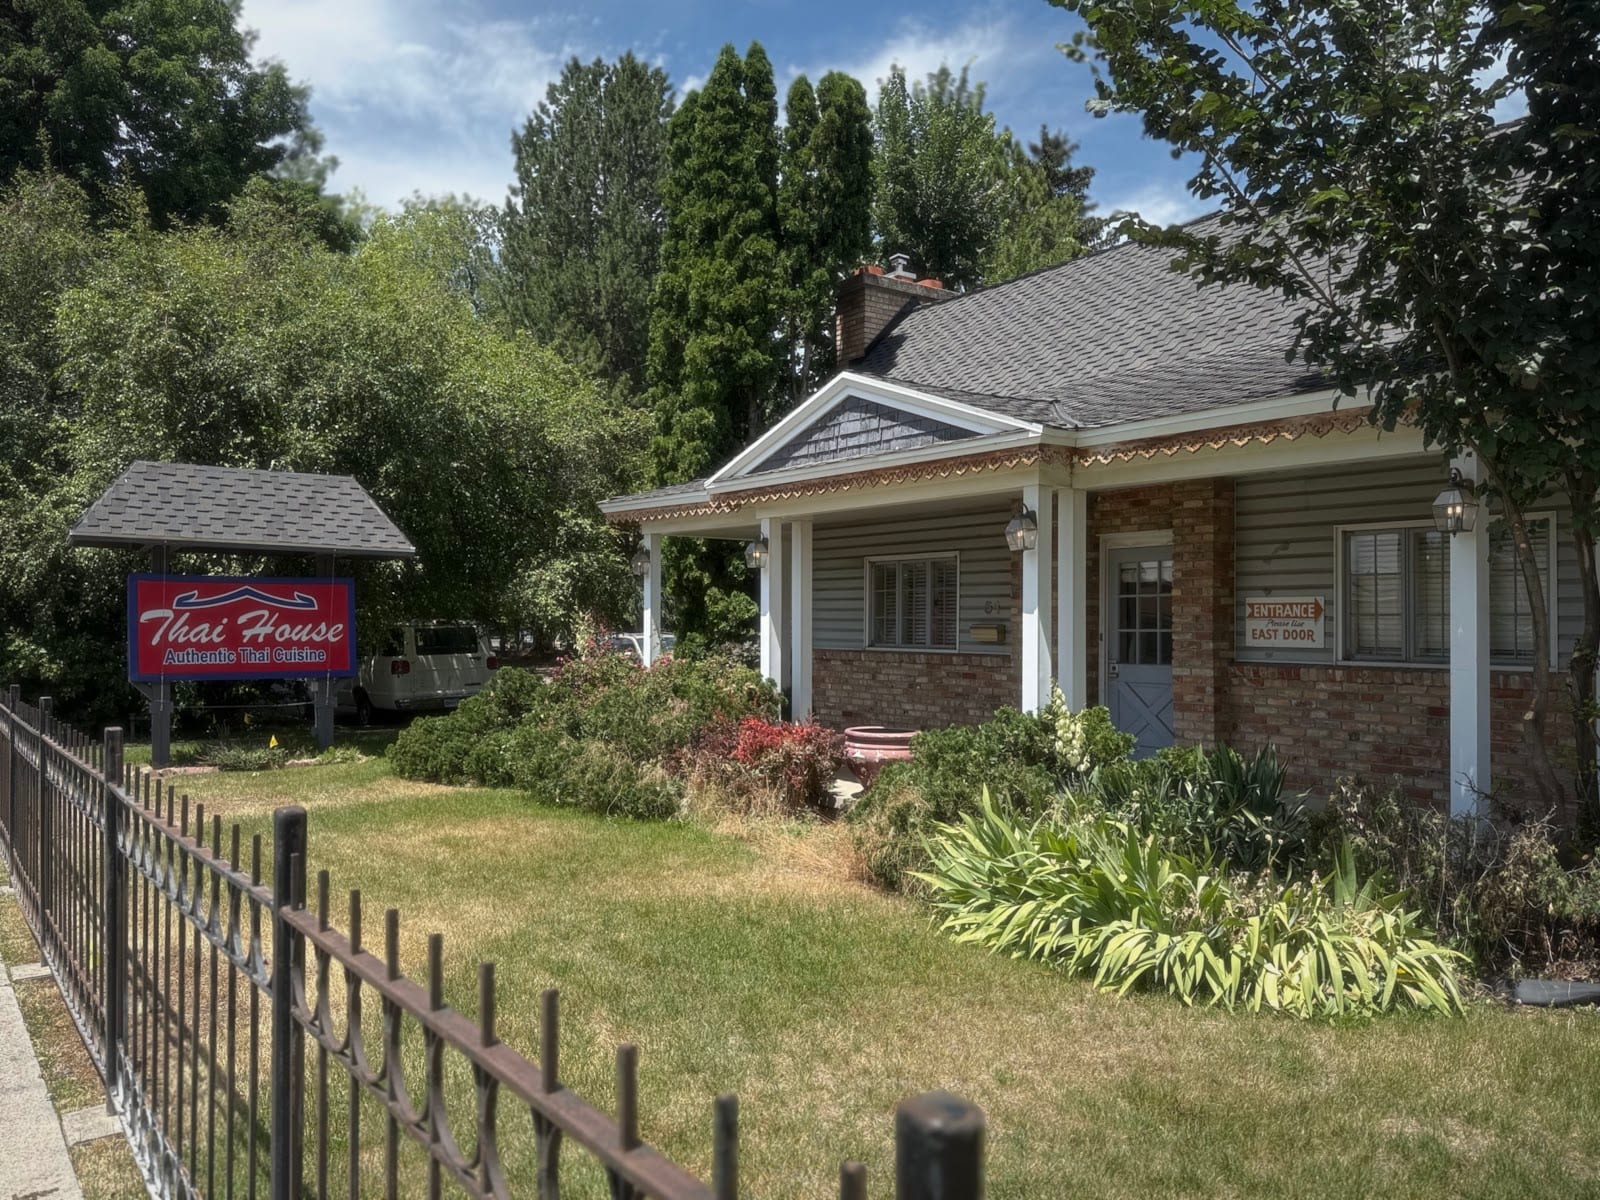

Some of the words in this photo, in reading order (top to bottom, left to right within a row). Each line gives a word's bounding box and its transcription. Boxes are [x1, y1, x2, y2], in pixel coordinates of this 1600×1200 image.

[1253, 604, 1315, 617] ENTRANCE
[140, 609, 228, 646] Thai
[237, 609, 344, 643] House
[1251, 628, 1279, 640] EAST
[1283, 629, 1315, 642] DOOR
[163, 648, 236, 665] Authentic
[239, 648, 270, 664] Thai
[273, 647, 327, 663] Cuisine
